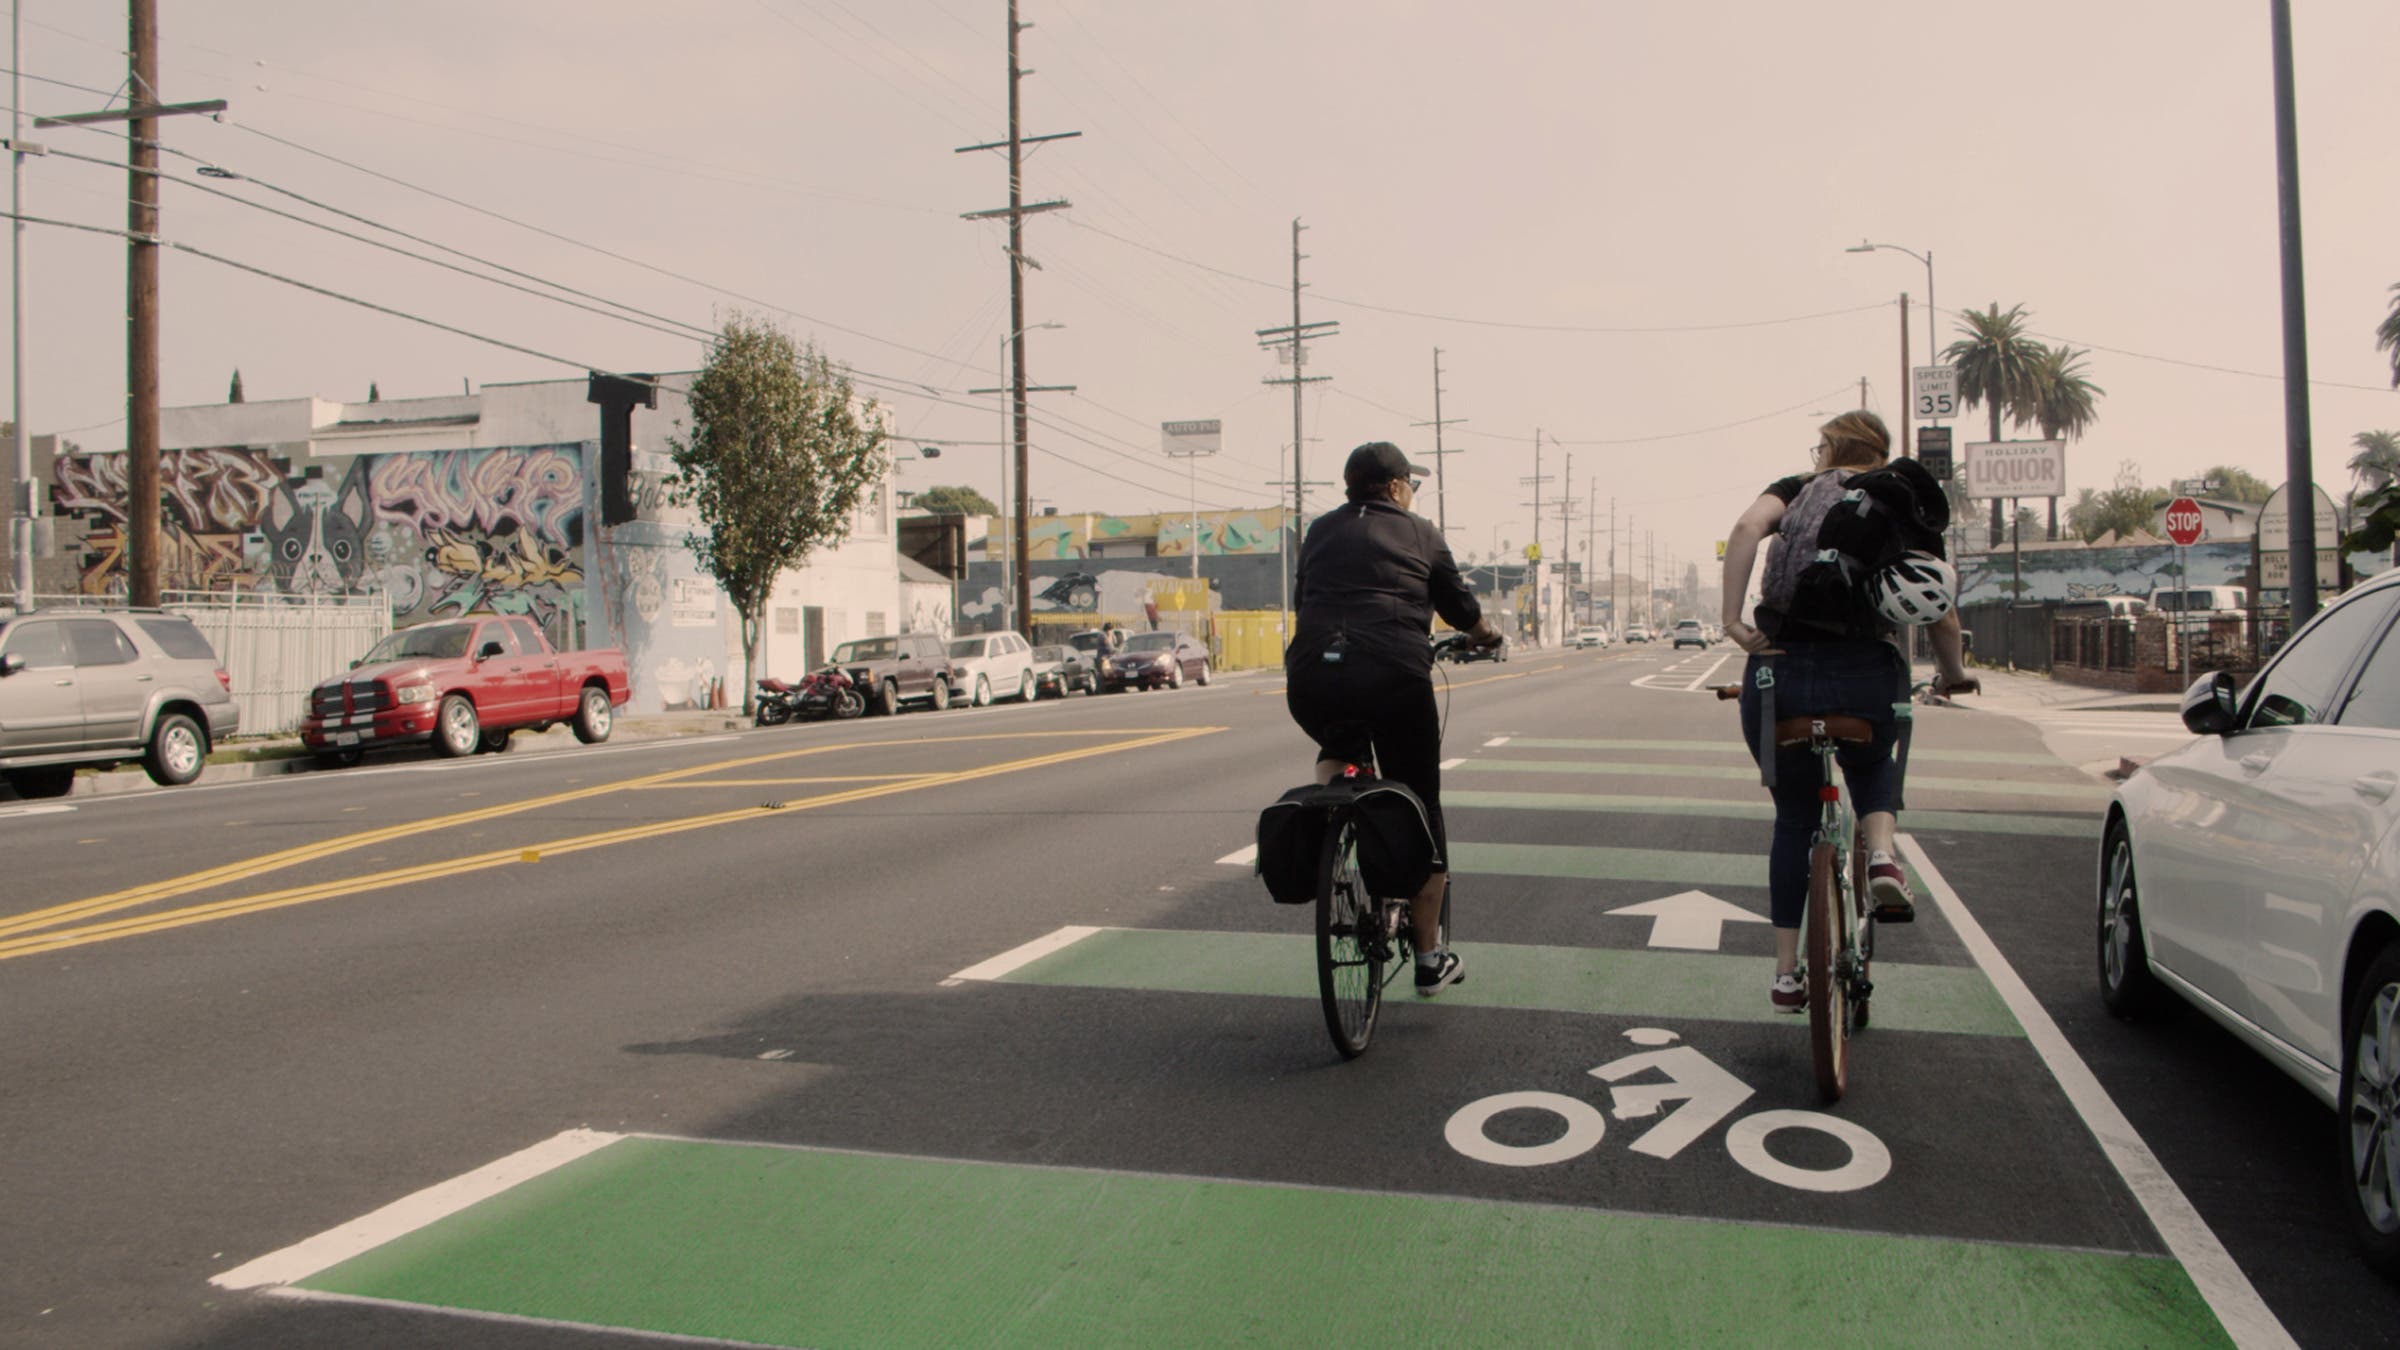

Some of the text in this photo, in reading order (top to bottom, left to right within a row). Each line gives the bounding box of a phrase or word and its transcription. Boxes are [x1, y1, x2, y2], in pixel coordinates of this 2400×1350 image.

[1917, 371, 1953, 380] SPEED
[1920, 382, 1949, 392] LIMIT
[1919, 394, 1953, 414] 35
[1985, 447, 2048, 457] HOLIDAY
[1975, 457, 2057, 485] LIQUOR
[2167, 512, 2201, 532] STOP
